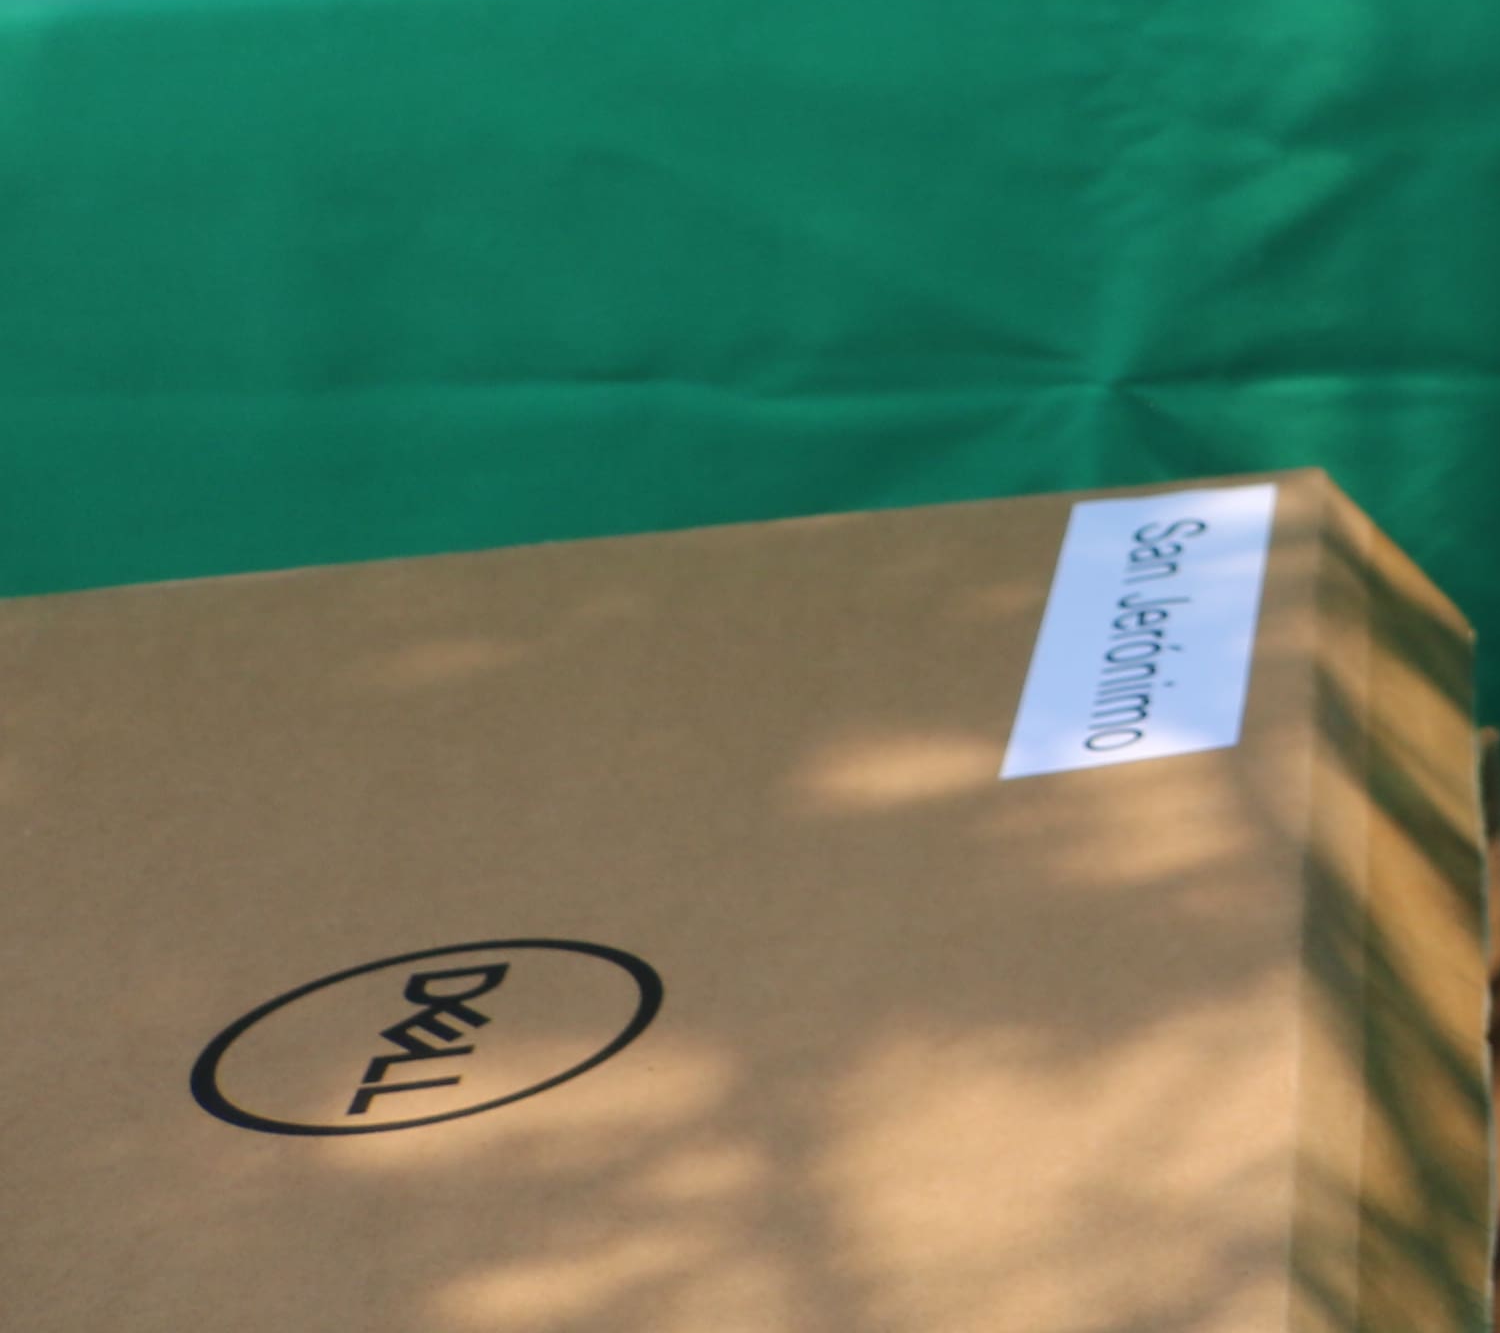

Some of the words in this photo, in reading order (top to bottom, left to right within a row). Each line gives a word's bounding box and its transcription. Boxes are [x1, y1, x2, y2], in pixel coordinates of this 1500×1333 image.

[1122, 517, 1209, 585] San
[1084, 590, 1193, 753] Jerónimo
[345, 961, 511, 1117] DELL
